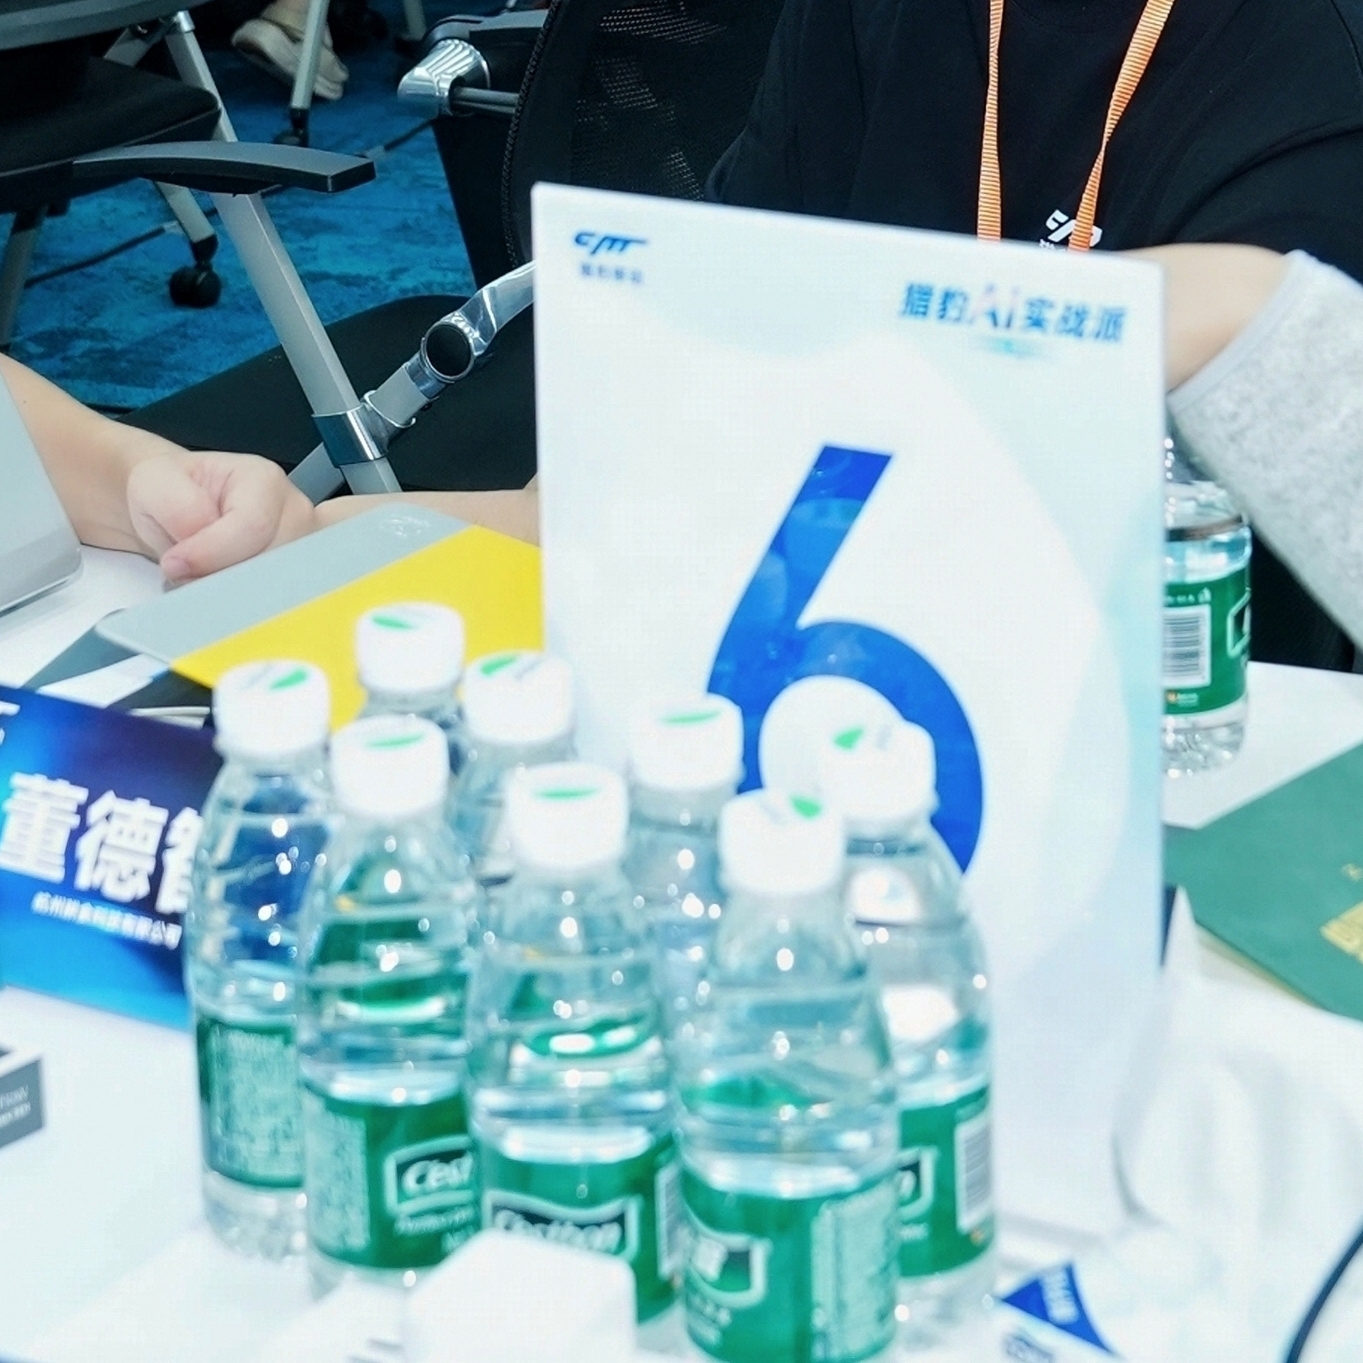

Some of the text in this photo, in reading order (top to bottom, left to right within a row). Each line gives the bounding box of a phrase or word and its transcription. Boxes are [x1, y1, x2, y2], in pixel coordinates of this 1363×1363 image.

[900, 283, 1127, 342] 猎豹AI实战派
[708, 445, 983, 875] 6
